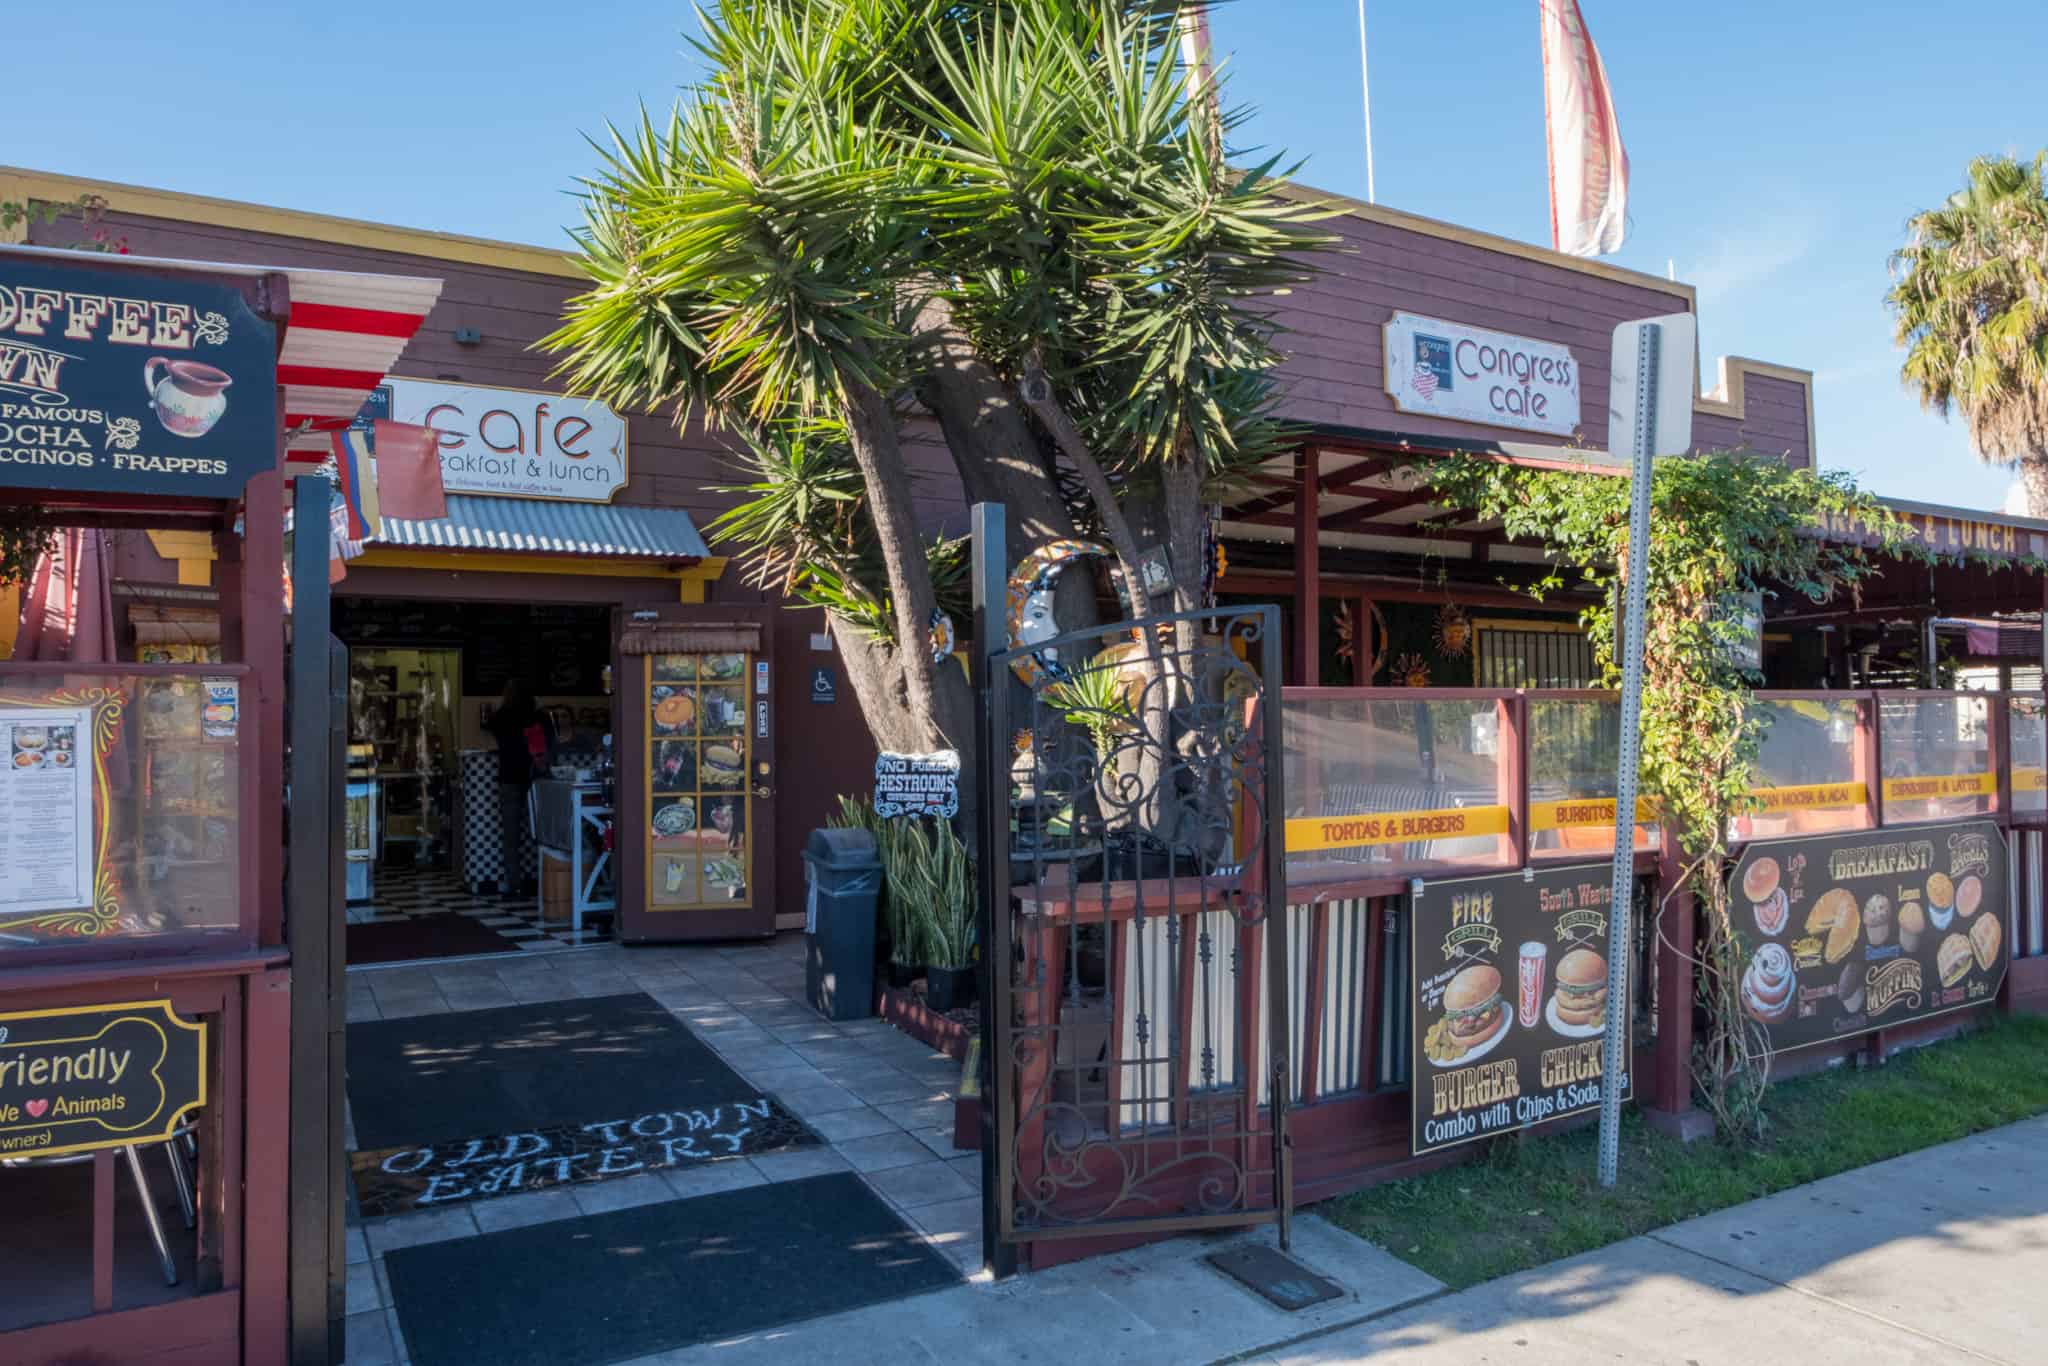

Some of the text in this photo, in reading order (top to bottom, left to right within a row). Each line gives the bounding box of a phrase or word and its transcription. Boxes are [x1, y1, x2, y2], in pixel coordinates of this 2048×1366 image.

[1455, 339, 1571, 386] Congress
[2, 403, 104, 424] FAMOUS
[113, 454, 228, 475] FRAPPES
[526, 458, 541, 477] &
[549, 460, 610, 482] lunch
[1948, 518, 2016, 553] LUNCH
[884, 761, 906, 773] NO
[879, 774, 956, 792] RESTROOMS
[1322, 814, 1465, 842] TORTAS & BURGERS
[1556, 804, 1615, 824] BURRITOS
[1830, 840, 1931, 880] BREAKFAST
[1432, 1058, 1521, 1117] BURGER
[52, 1093, 126, 1118] Animals
[1424, 1110, 1476, 1144] Combo
[1480, 1102, 1511, 1129] with
[1516, 1094, 1554, 1121] Chips
[1556, 1089, 1567, 1111] &
[1567, 1081, 1600, 1108] Soda
[381, 1099, 770, 1173] OLD TOWN
[416, 1128, 752, 1204] EATERY
